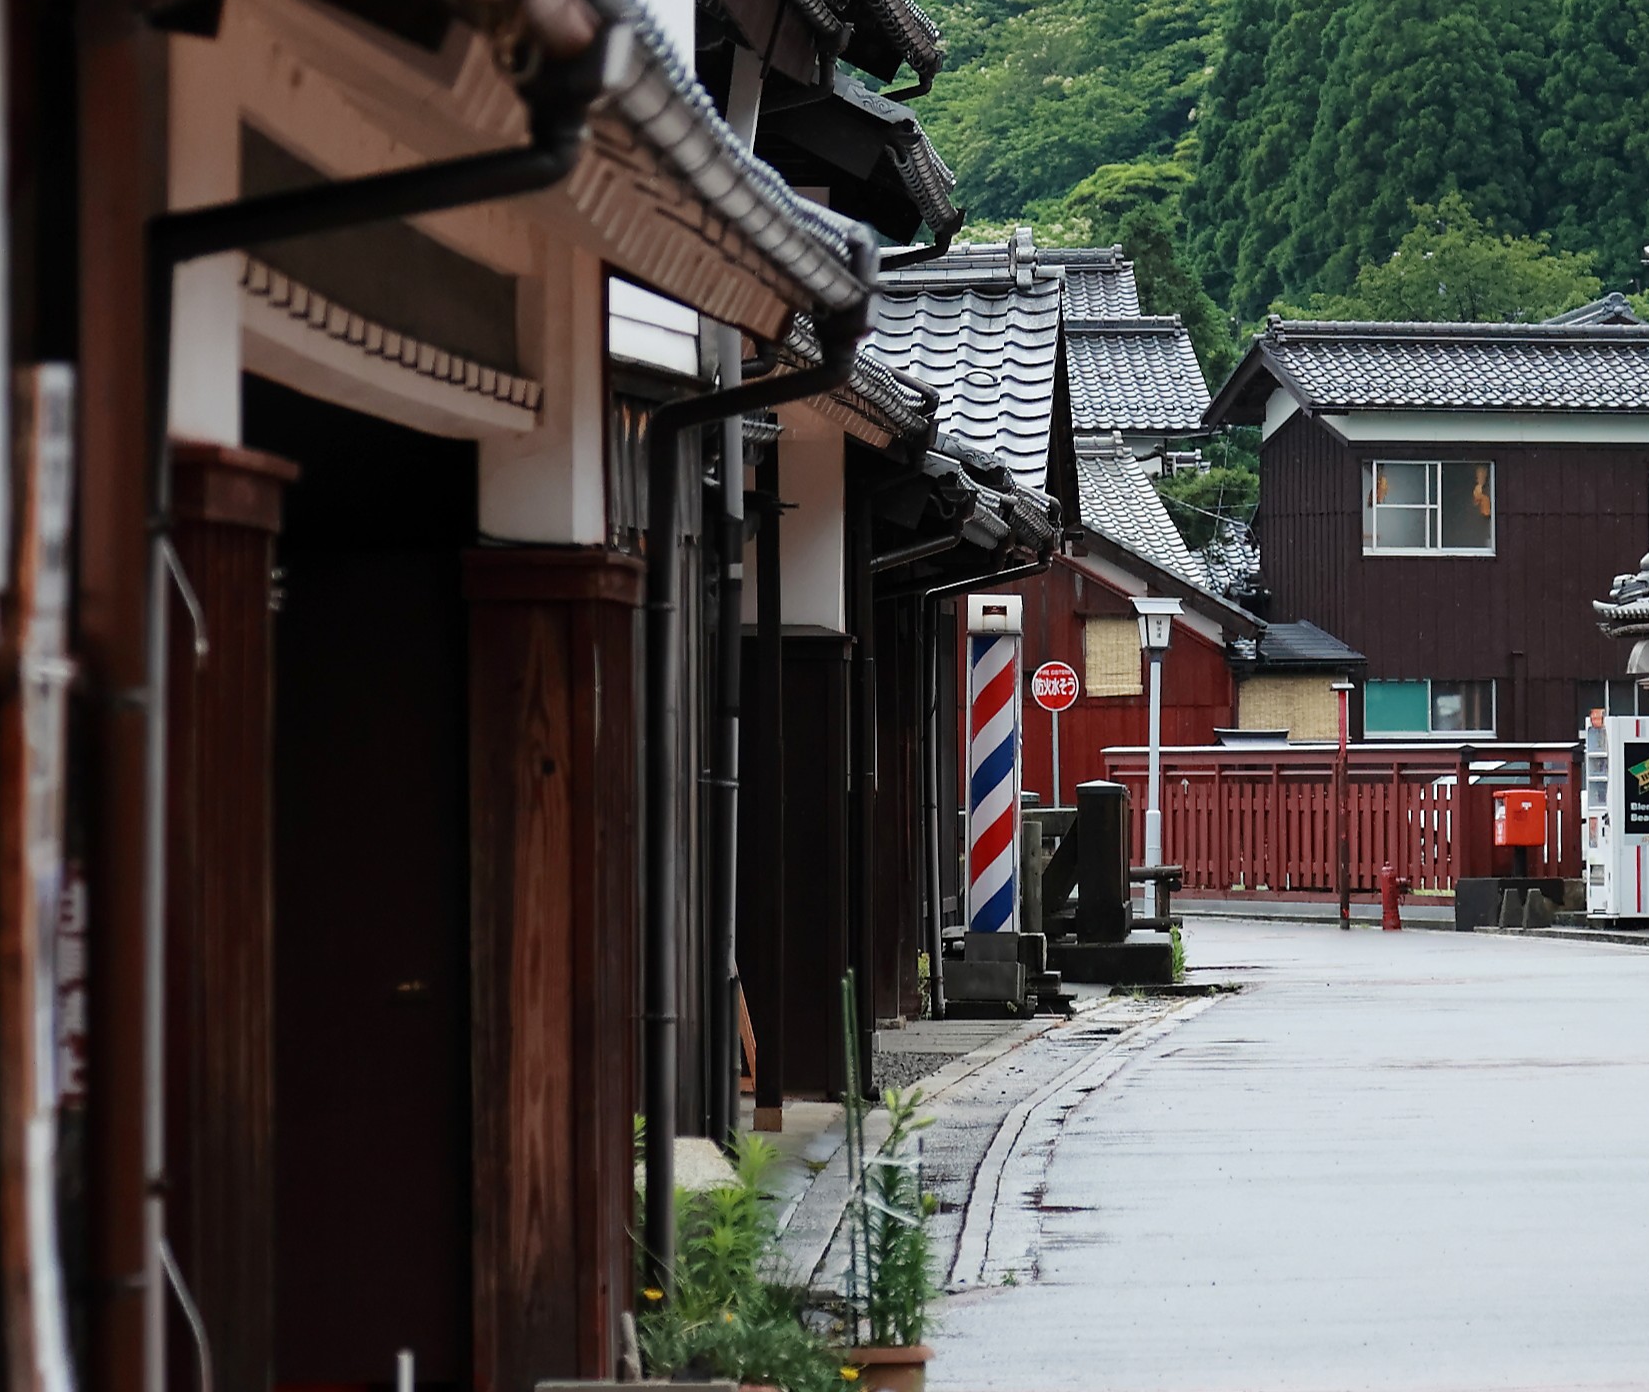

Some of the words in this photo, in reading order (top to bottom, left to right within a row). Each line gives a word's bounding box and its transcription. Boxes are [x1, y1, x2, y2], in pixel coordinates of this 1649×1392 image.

[1034, 677, 1076, 696] 防火水そう
